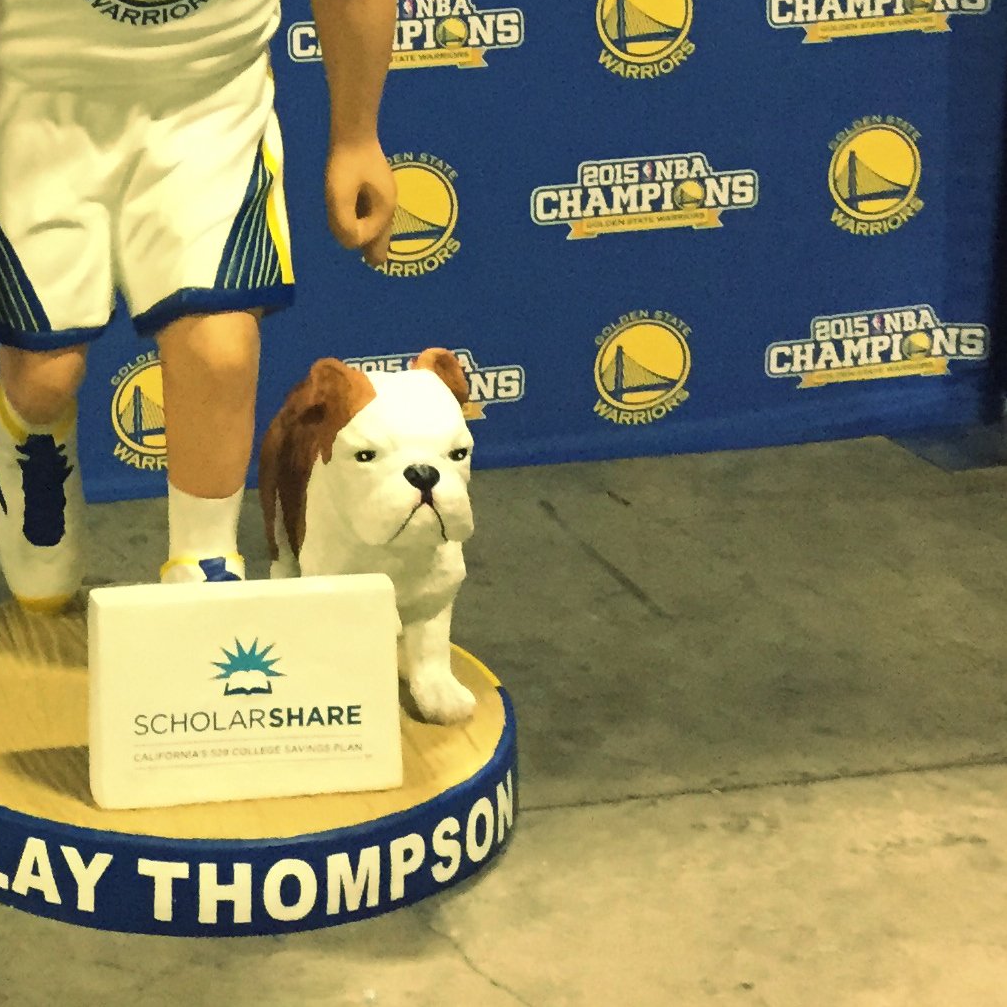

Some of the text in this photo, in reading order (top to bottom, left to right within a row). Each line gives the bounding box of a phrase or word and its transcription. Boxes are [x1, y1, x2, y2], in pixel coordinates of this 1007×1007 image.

[599, 40, 695, 79] WARRIORS
[419, 153, 458, 181] STATE
[583, 157, 707, 187] 2015 NBA
[535, 174, 753, 221] CHAMPIONS
[815, 310, 935, 341] 2015 NBA
[769, 324, 979, 374] CHAMPIONS
[134, 705, 362, 736] SCHOLARSHARE
[232, 744, 282, 757] COLLEGE
[333, 742, 363, 753] PLAN
[138, 768, 513, 925] THOMPSON
